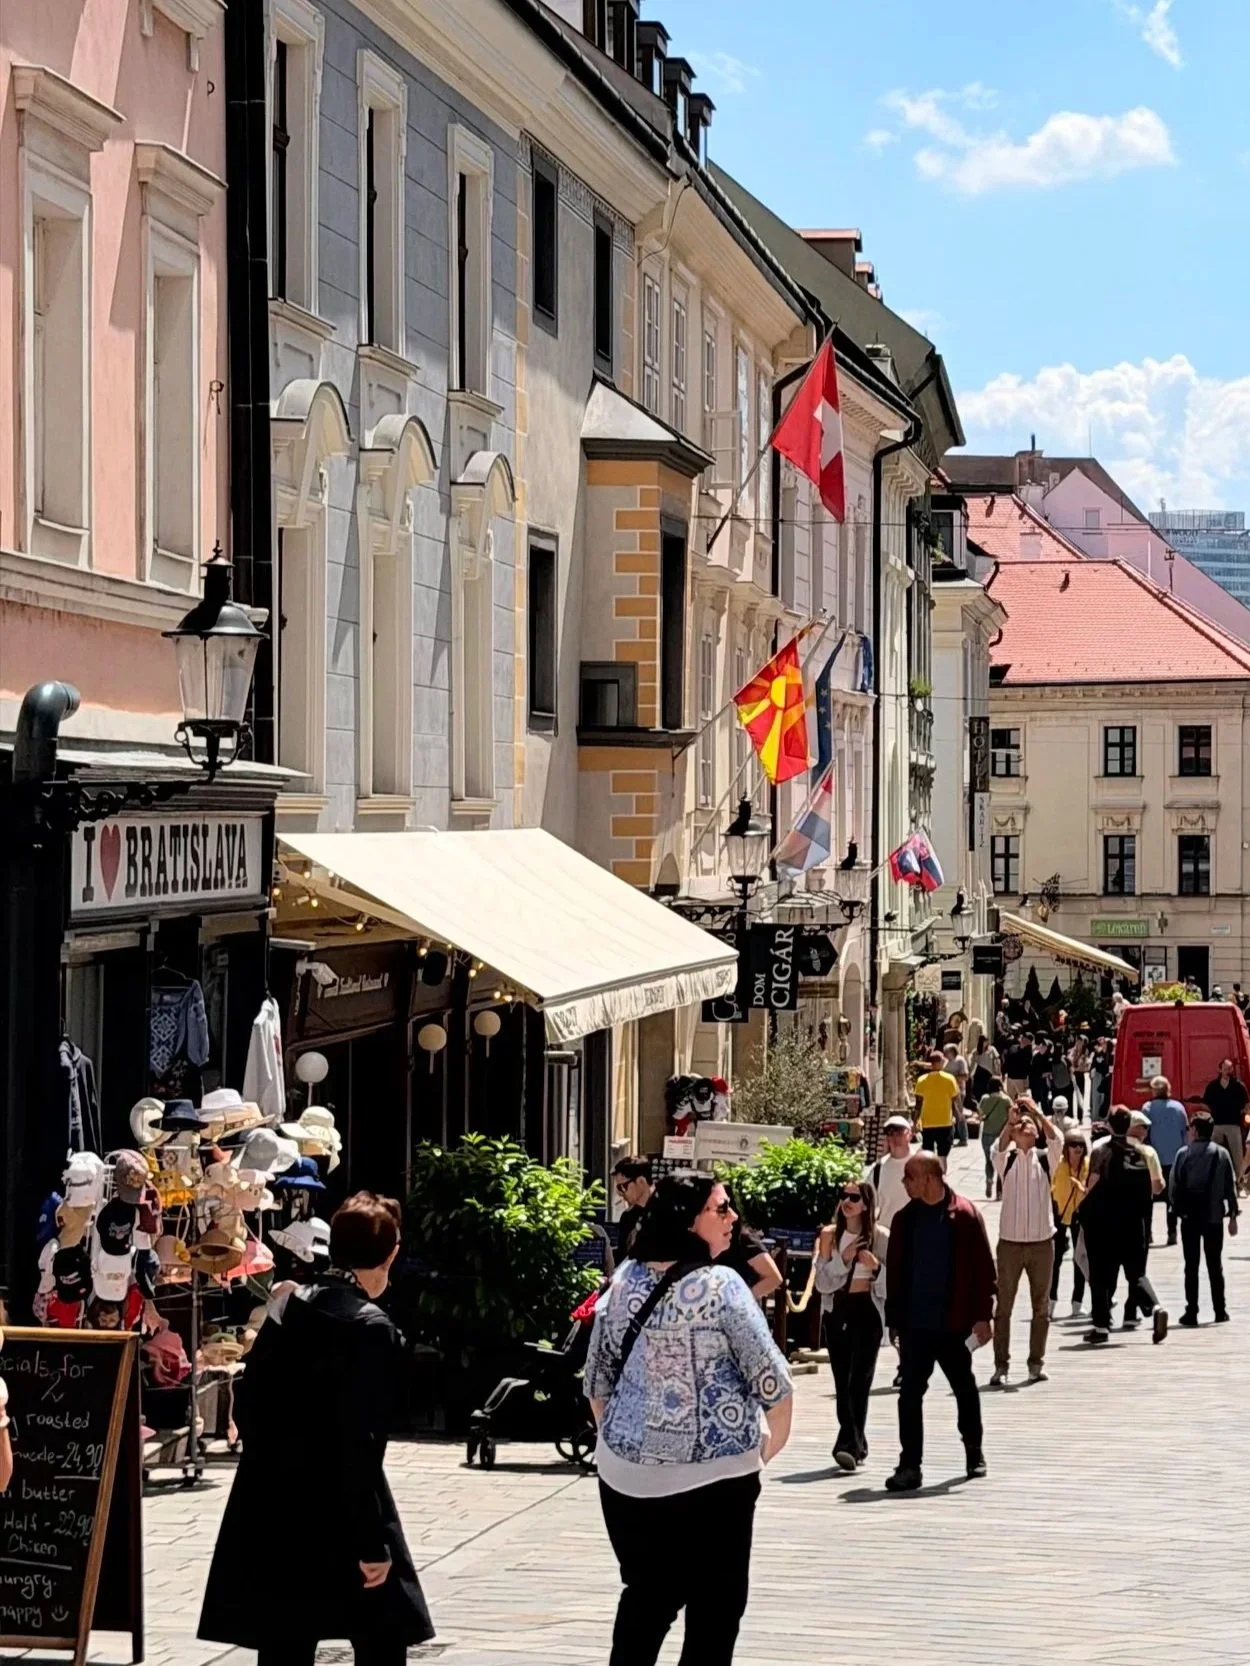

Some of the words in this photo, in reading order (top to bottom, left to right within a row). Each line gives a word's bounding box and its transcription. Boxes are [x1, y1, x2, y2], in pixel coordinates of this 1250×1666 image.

[973, 721, 985, 790] HOTEL
[82, 826, 96, 904] I
[125, 823, 248, 898] BRATISLAVA
[769, 927, 795, 1008] CIGÁR
[753, 973, 766, 1006] DOM
[59, 1353, 94, 1378] for
[41, 1371, 65, 1402] 2
[26, 1411, 90, 1429] roasted
[22, 1479, 76, 1501] butter
[4, 1510, 38, 1531] Half
